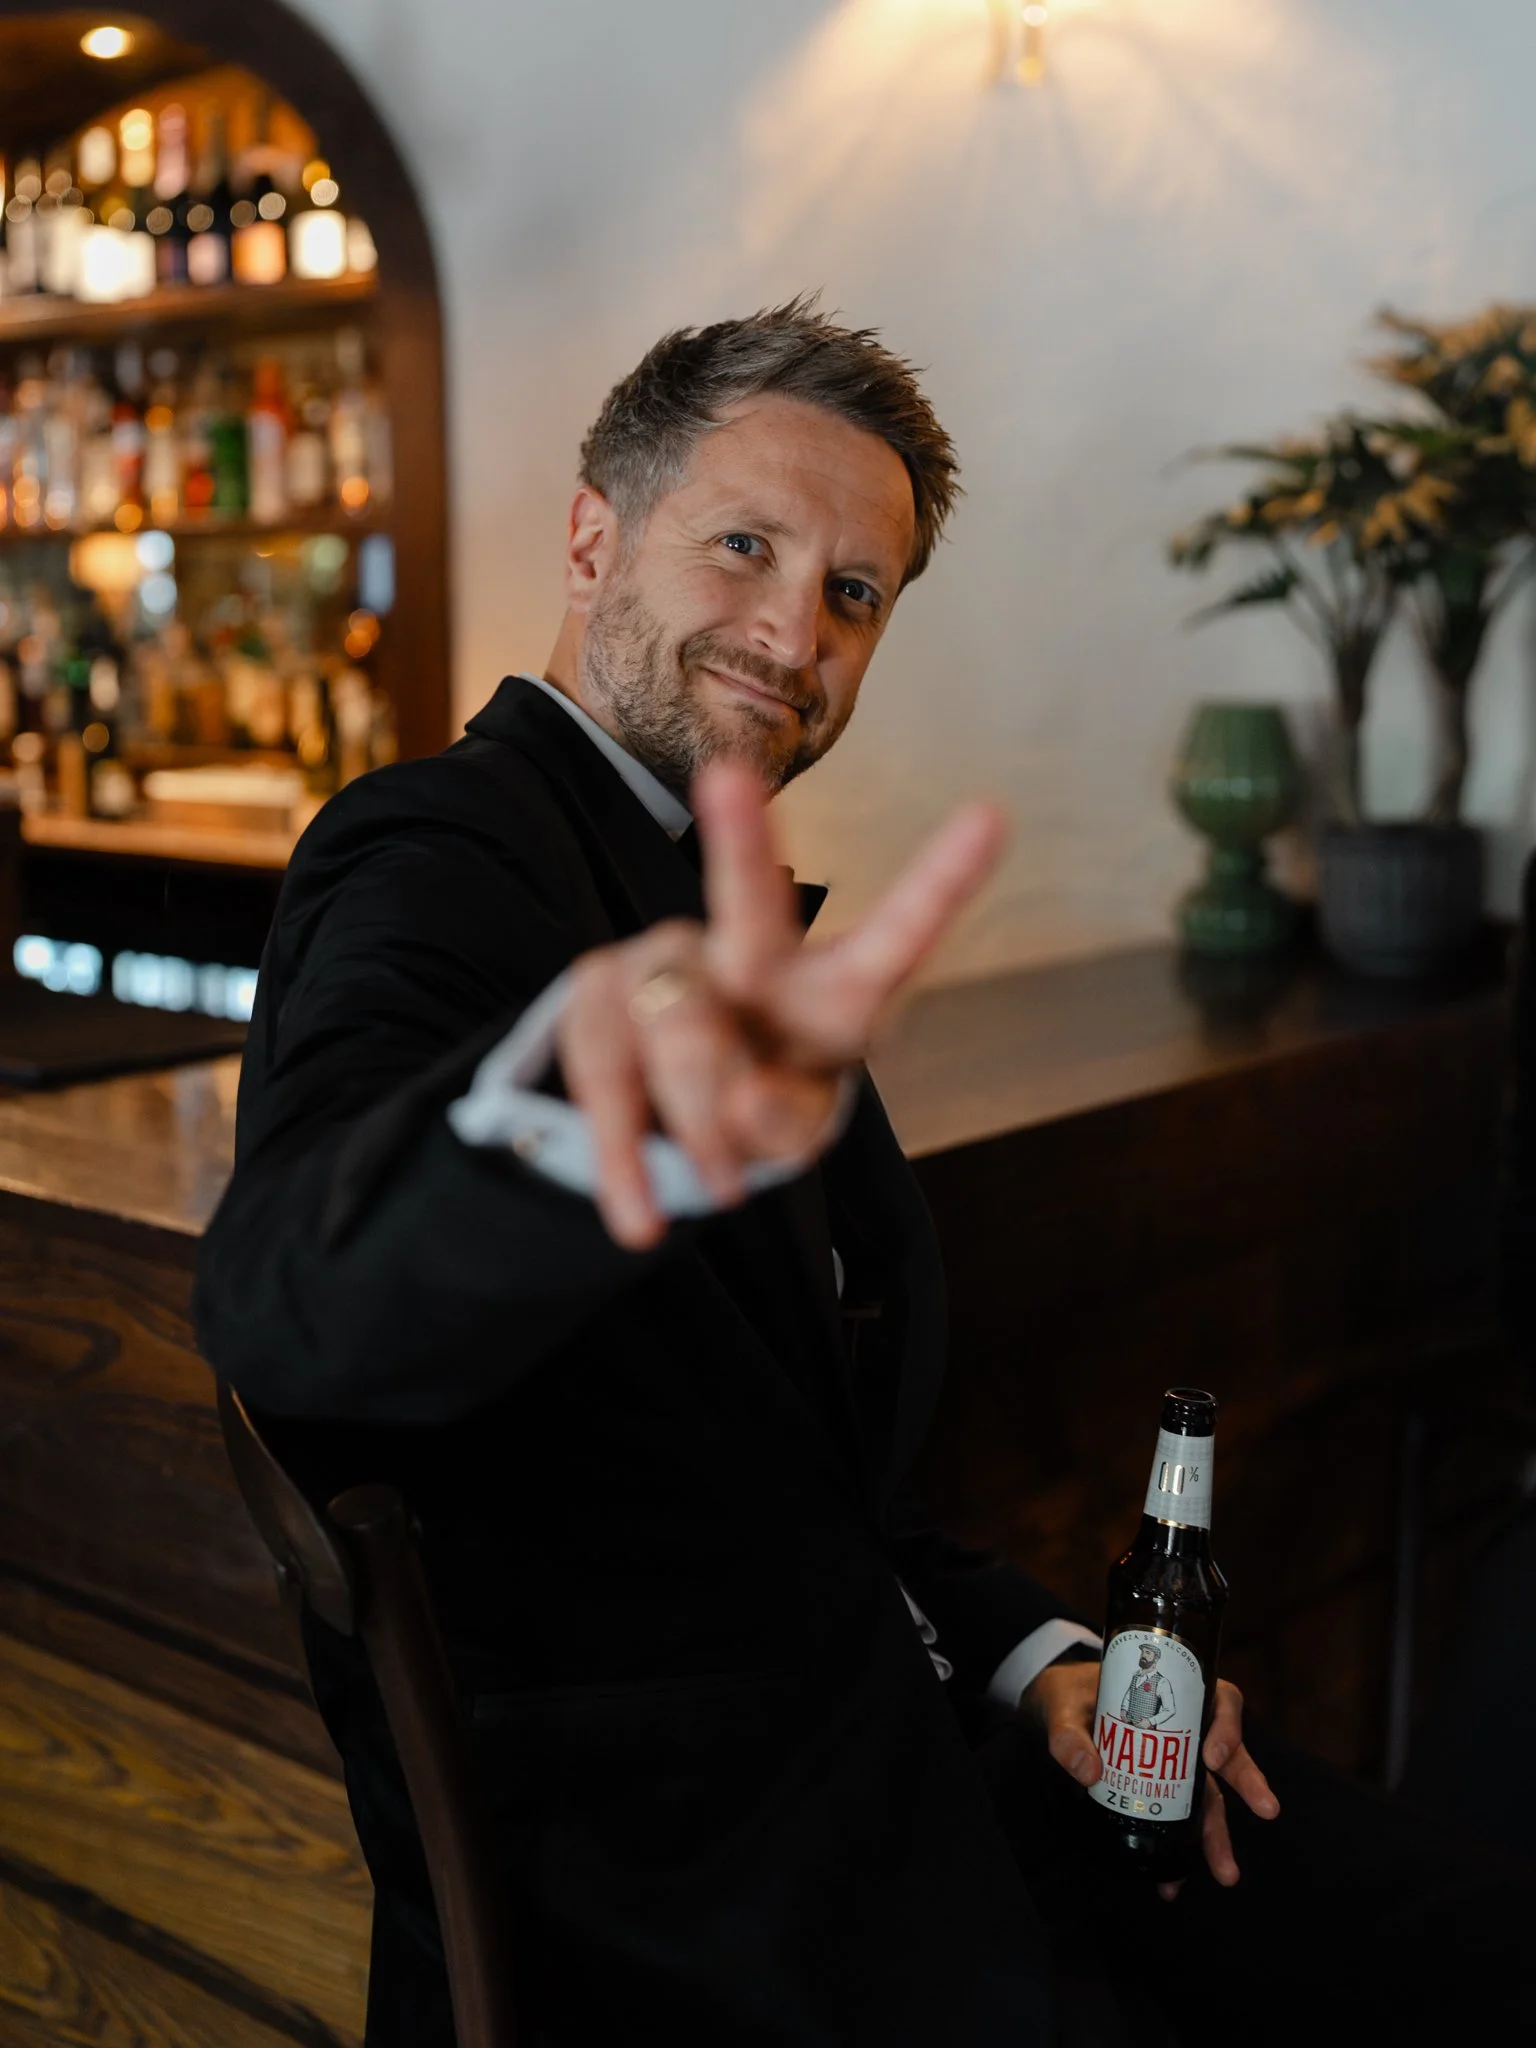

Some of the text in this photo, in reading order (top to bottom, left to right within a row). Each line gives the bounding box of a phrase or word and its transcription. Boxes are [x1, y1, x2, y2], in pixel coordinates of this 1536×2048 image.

[1109, 1634, 1198, 1673] CERVEZA SIN ALCOHOL
[1098, 1715, 1191, 1780] MADRÍ
[1099, 1768, 1177, 1799] XCEPCIONAL
[1106, 1789, 1162, 1816] ZERO
